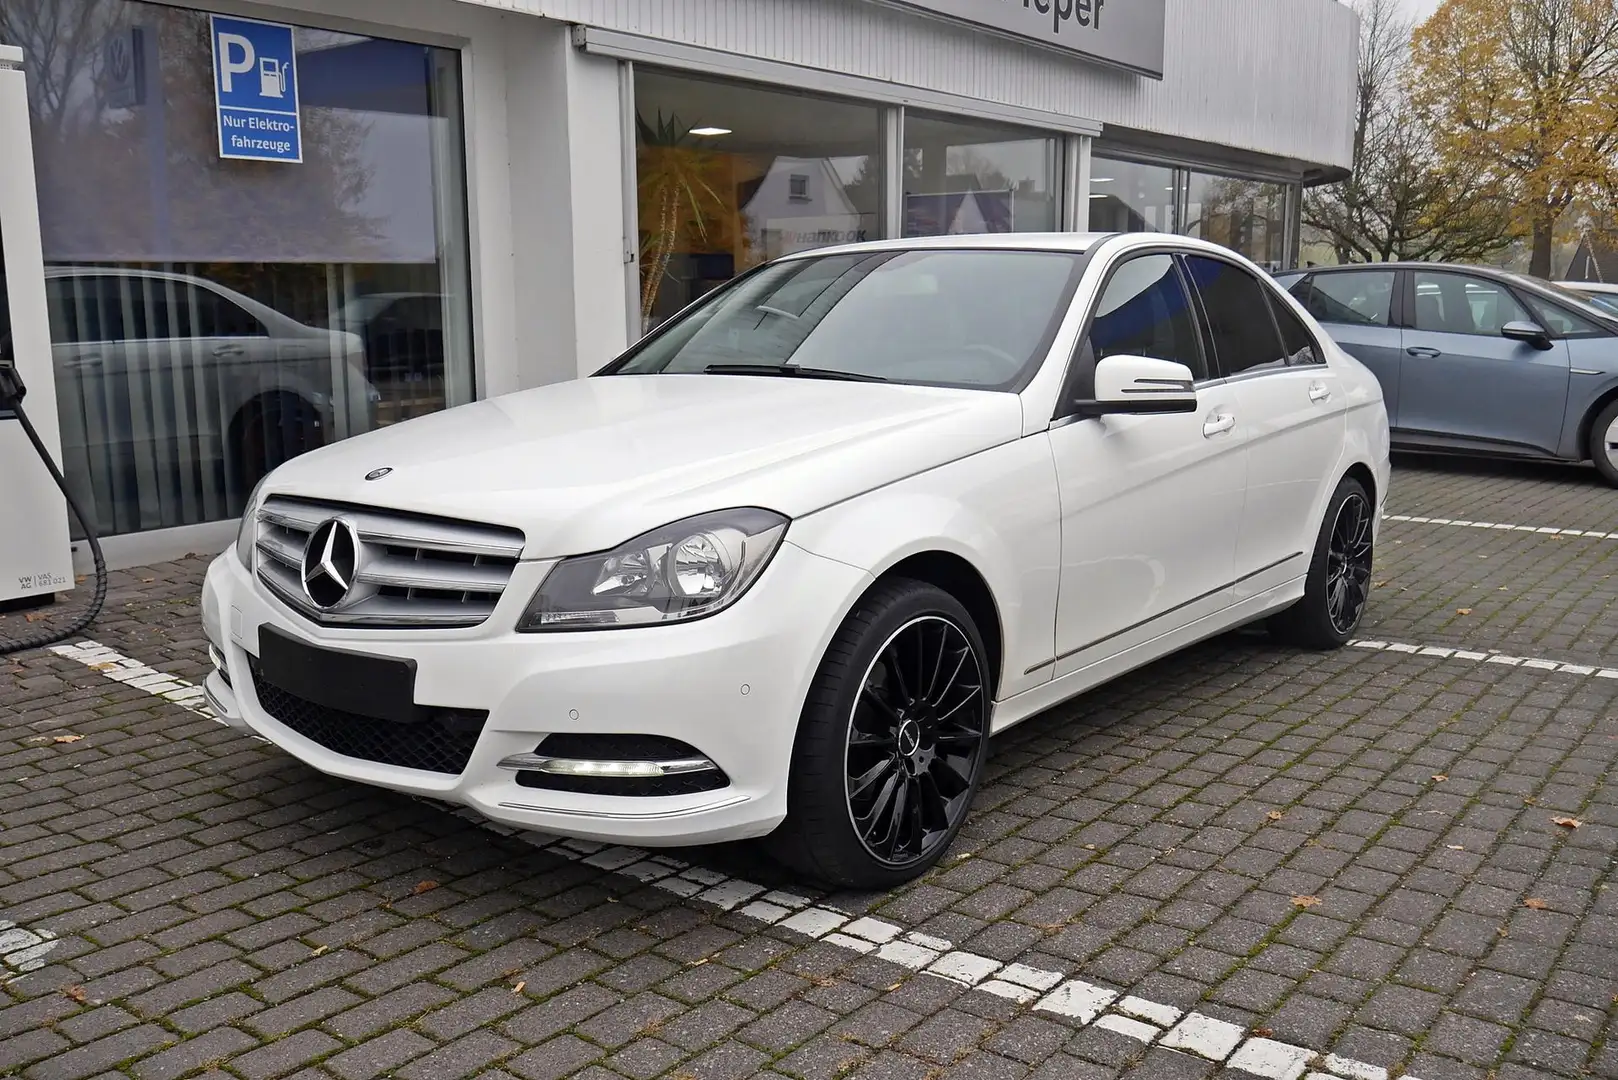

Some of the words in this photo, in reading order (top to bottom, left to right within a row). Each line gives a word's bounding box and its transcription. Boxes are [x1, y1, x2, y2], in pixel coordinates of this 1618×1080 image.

[218, 32, 255, 93] P
[223, 115, 247, 128] Nur
[248, 117, 295, 133] Elektro-
[231, 134, 291, 154] fahrzeuge
[18, 575, 32, 583] VW
